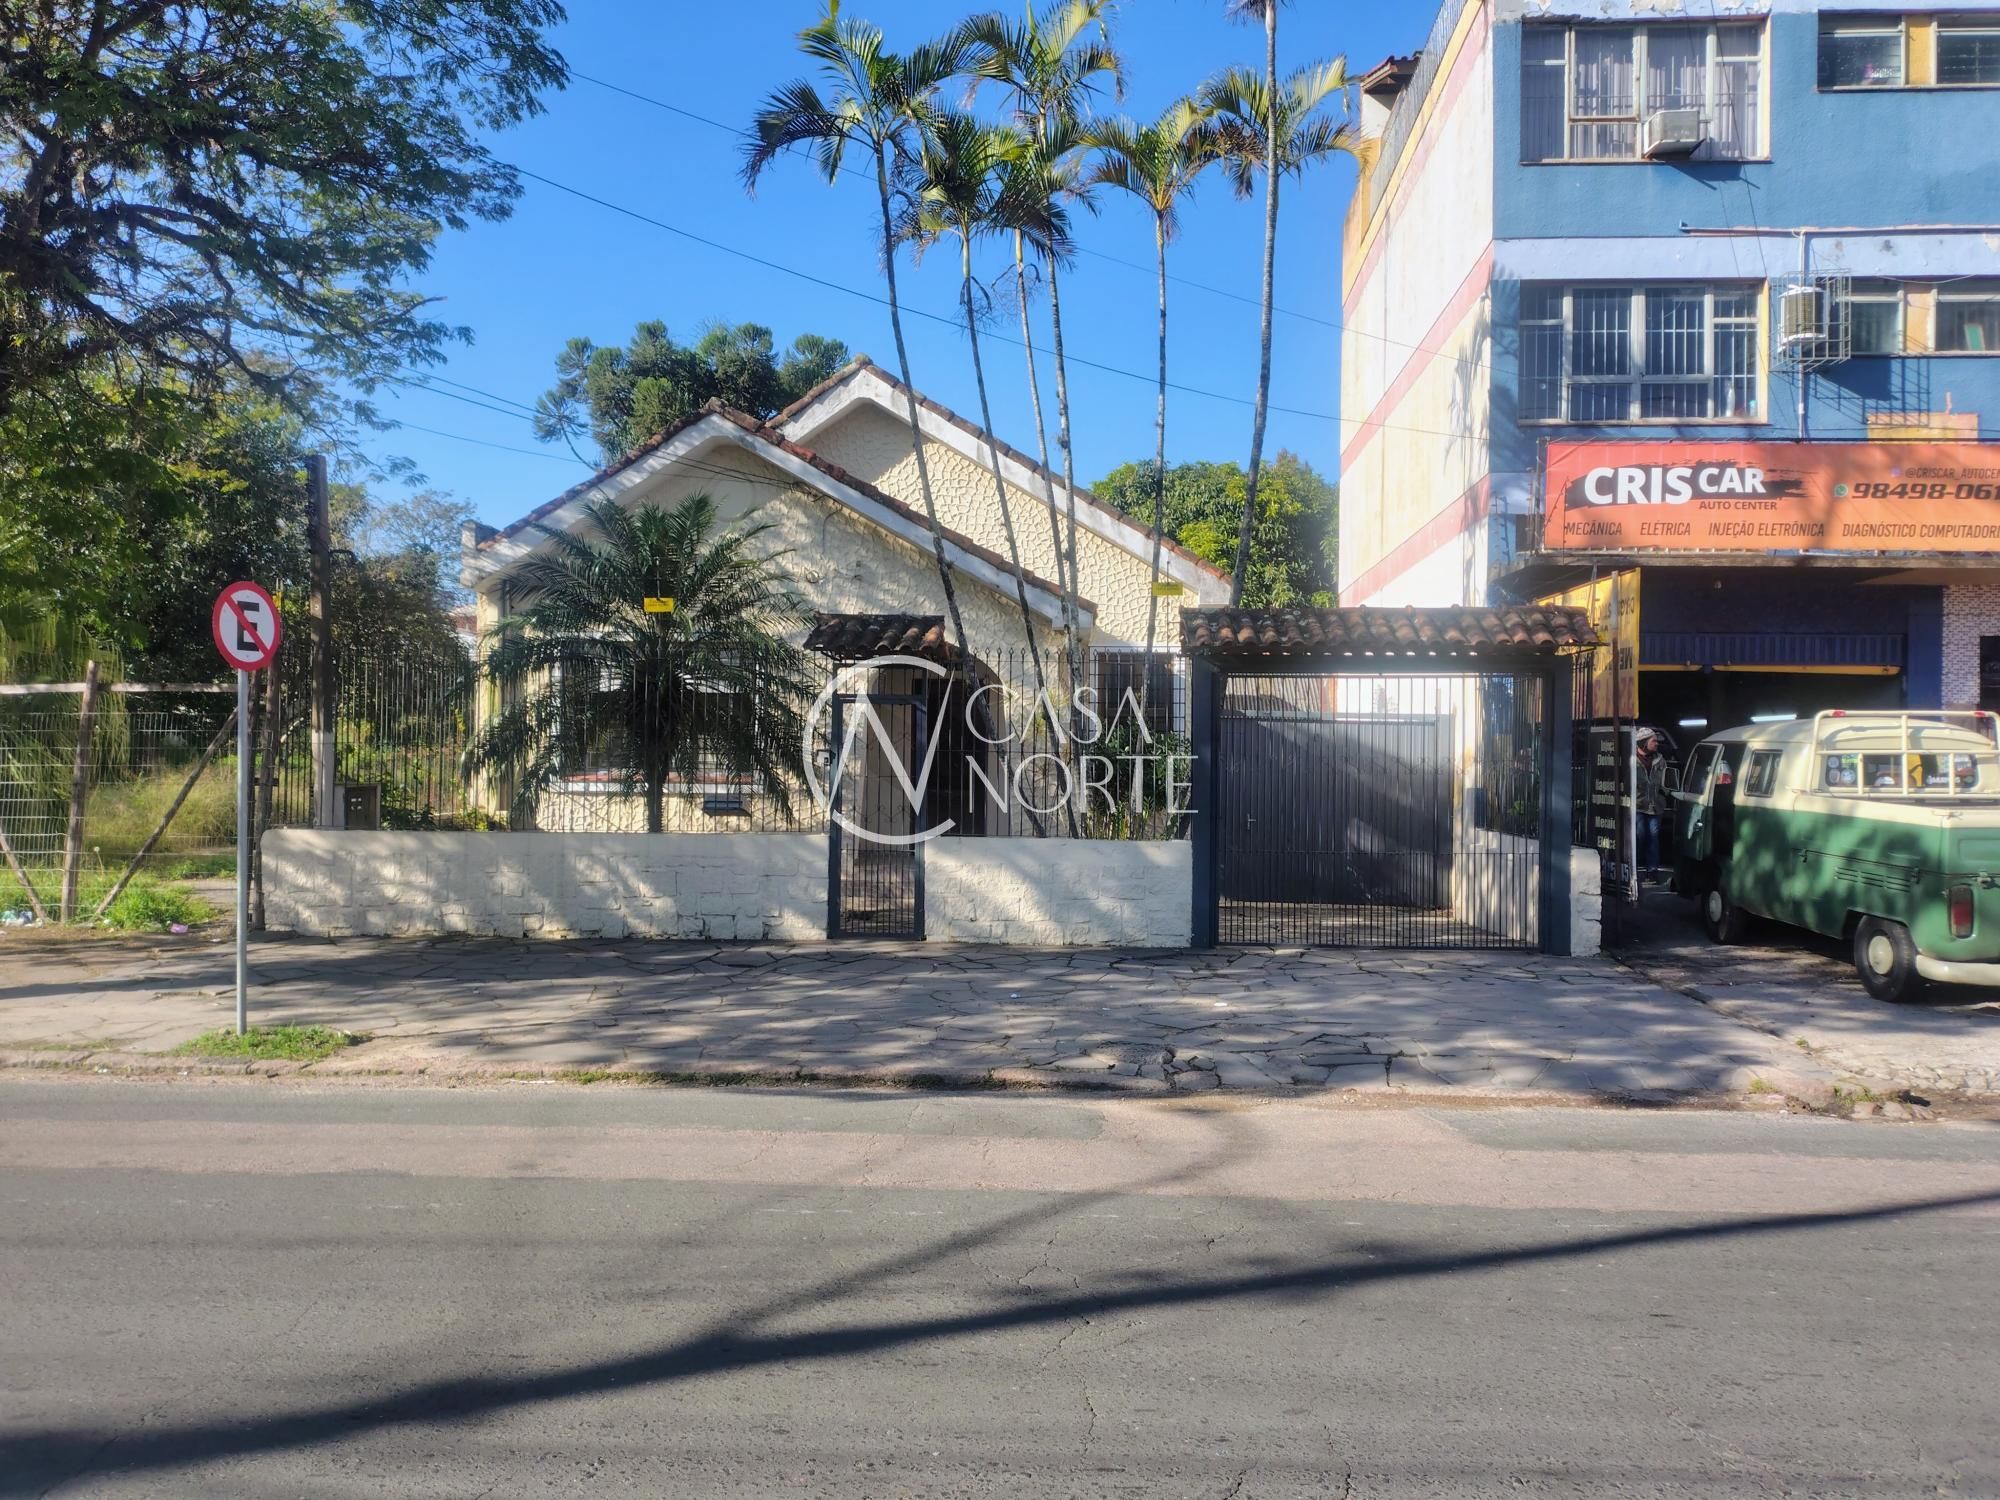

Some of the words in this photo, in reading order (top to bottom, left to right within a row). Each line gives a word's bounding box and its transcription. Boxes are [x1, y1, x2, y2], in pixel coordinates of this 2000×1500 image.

[1584, 466, 1693, 505] CRIS
[1698, 467, 1766, 493] CAR
[1700, 501, 1731, 510] AUTO
[1735, 501, 1777, 511] CENTER
[1565, 520, 1622, 536] MECÂNICA
[1640, 520, 1691, 536] ELÉTRICA
[1708, 520, 1754, 538] INJEÇÃO
[1758, 520, 1825, 537] ELETRÔNICA
[1842, 521, 1917, 538] DIAGNÓSTICO
